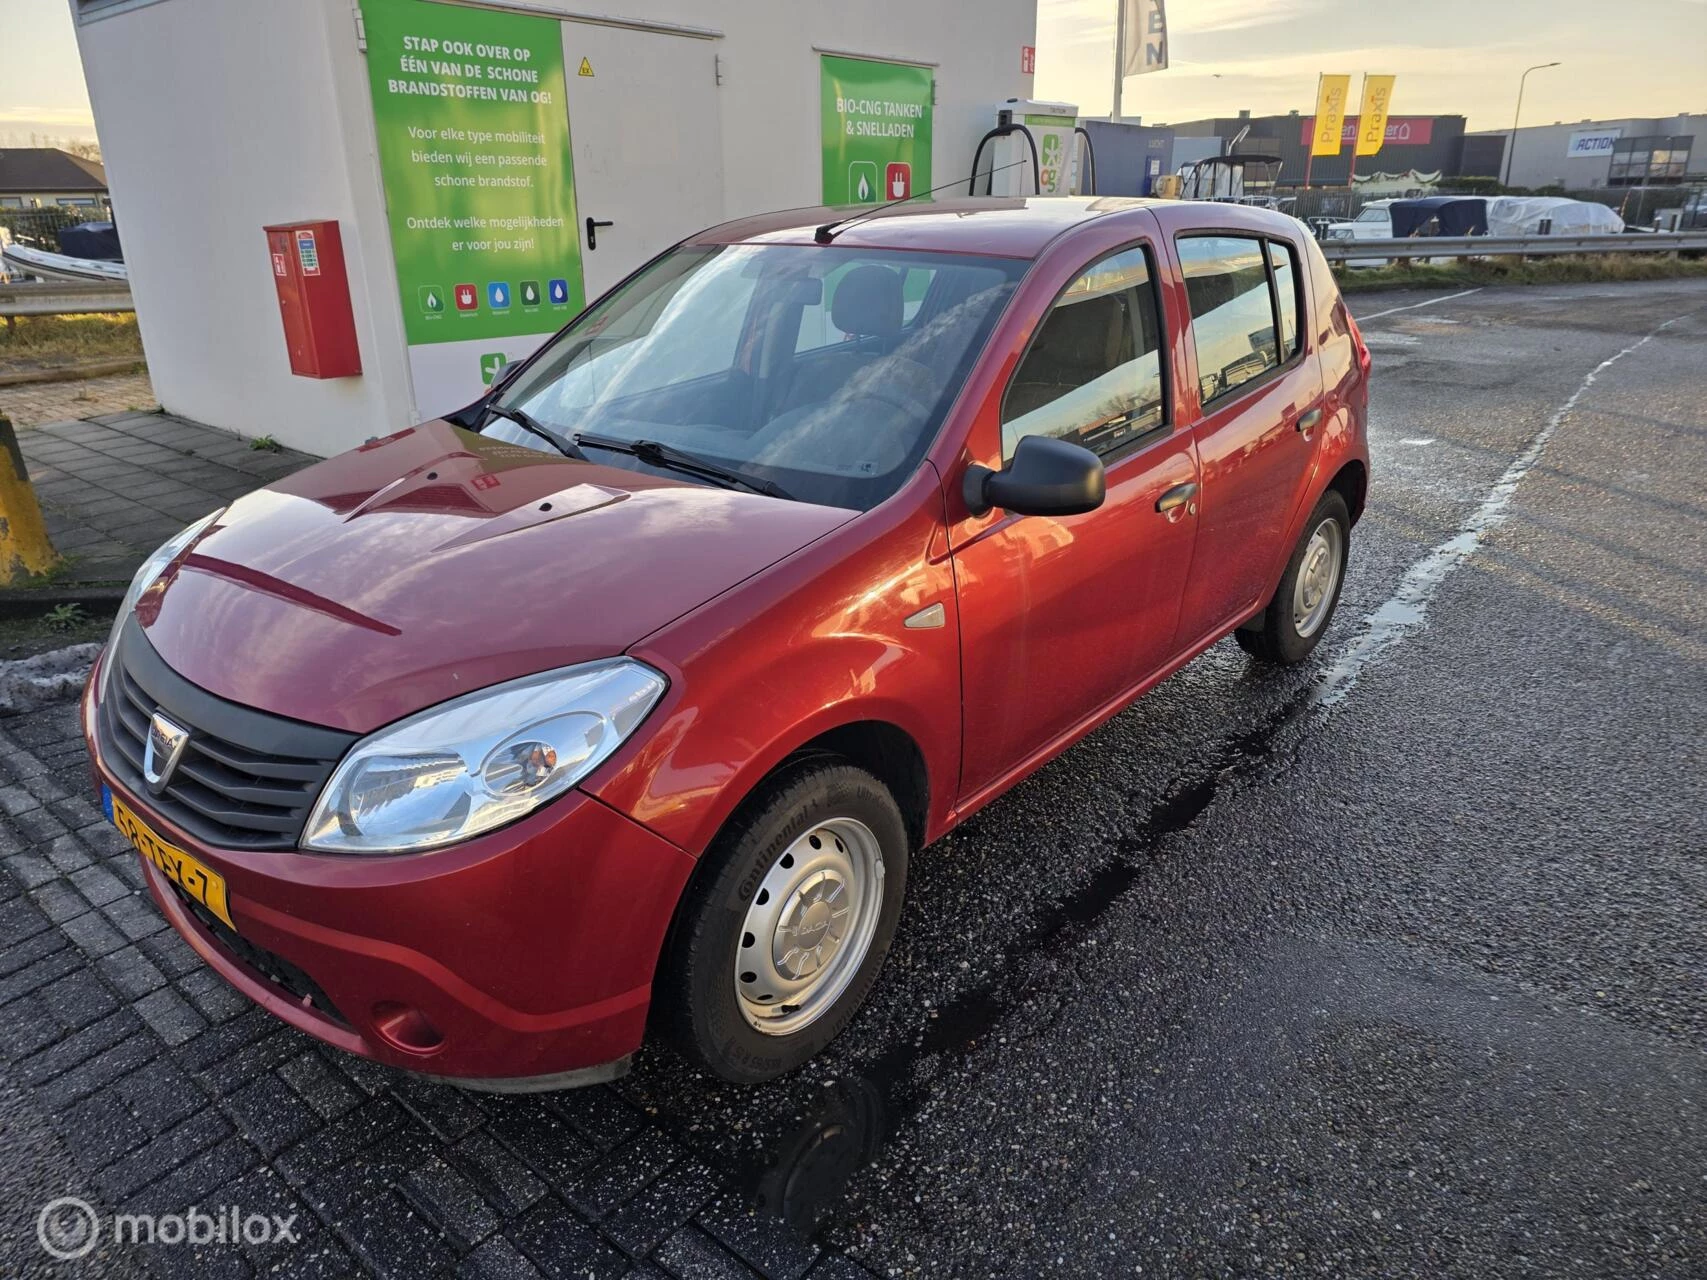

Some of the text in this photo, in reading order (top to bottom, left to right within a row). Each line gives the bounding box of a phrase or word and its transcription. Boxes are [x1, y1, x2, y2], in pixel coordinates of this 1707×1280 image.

[403, 36, 531, 62] STAP OOK OVER OP
[400, 55, 538, 83] ÉÉN VAN DE SCHONE
[388, 79, 552, 104] BRANDSTOFFEN VAN OG!
[836, 98, 922, 119] BIO-CNG TANKEN
[1321, 87, 1342, 143] Praxis
[1366, 87, 1386, 143] Praxis
[408, 126, 545, 144] Voor elke type mobiliteit
[846, 121, 914, 138] & SNELLADEN
[412, 150, 547, 168] bieden wij een passende
[434, 173, 534, 188] schone brandstof.
[407, 216, 564, 231] Ontdek welke mogelijkheden
[452, 238, 535, 253] er voor jou zijn!
